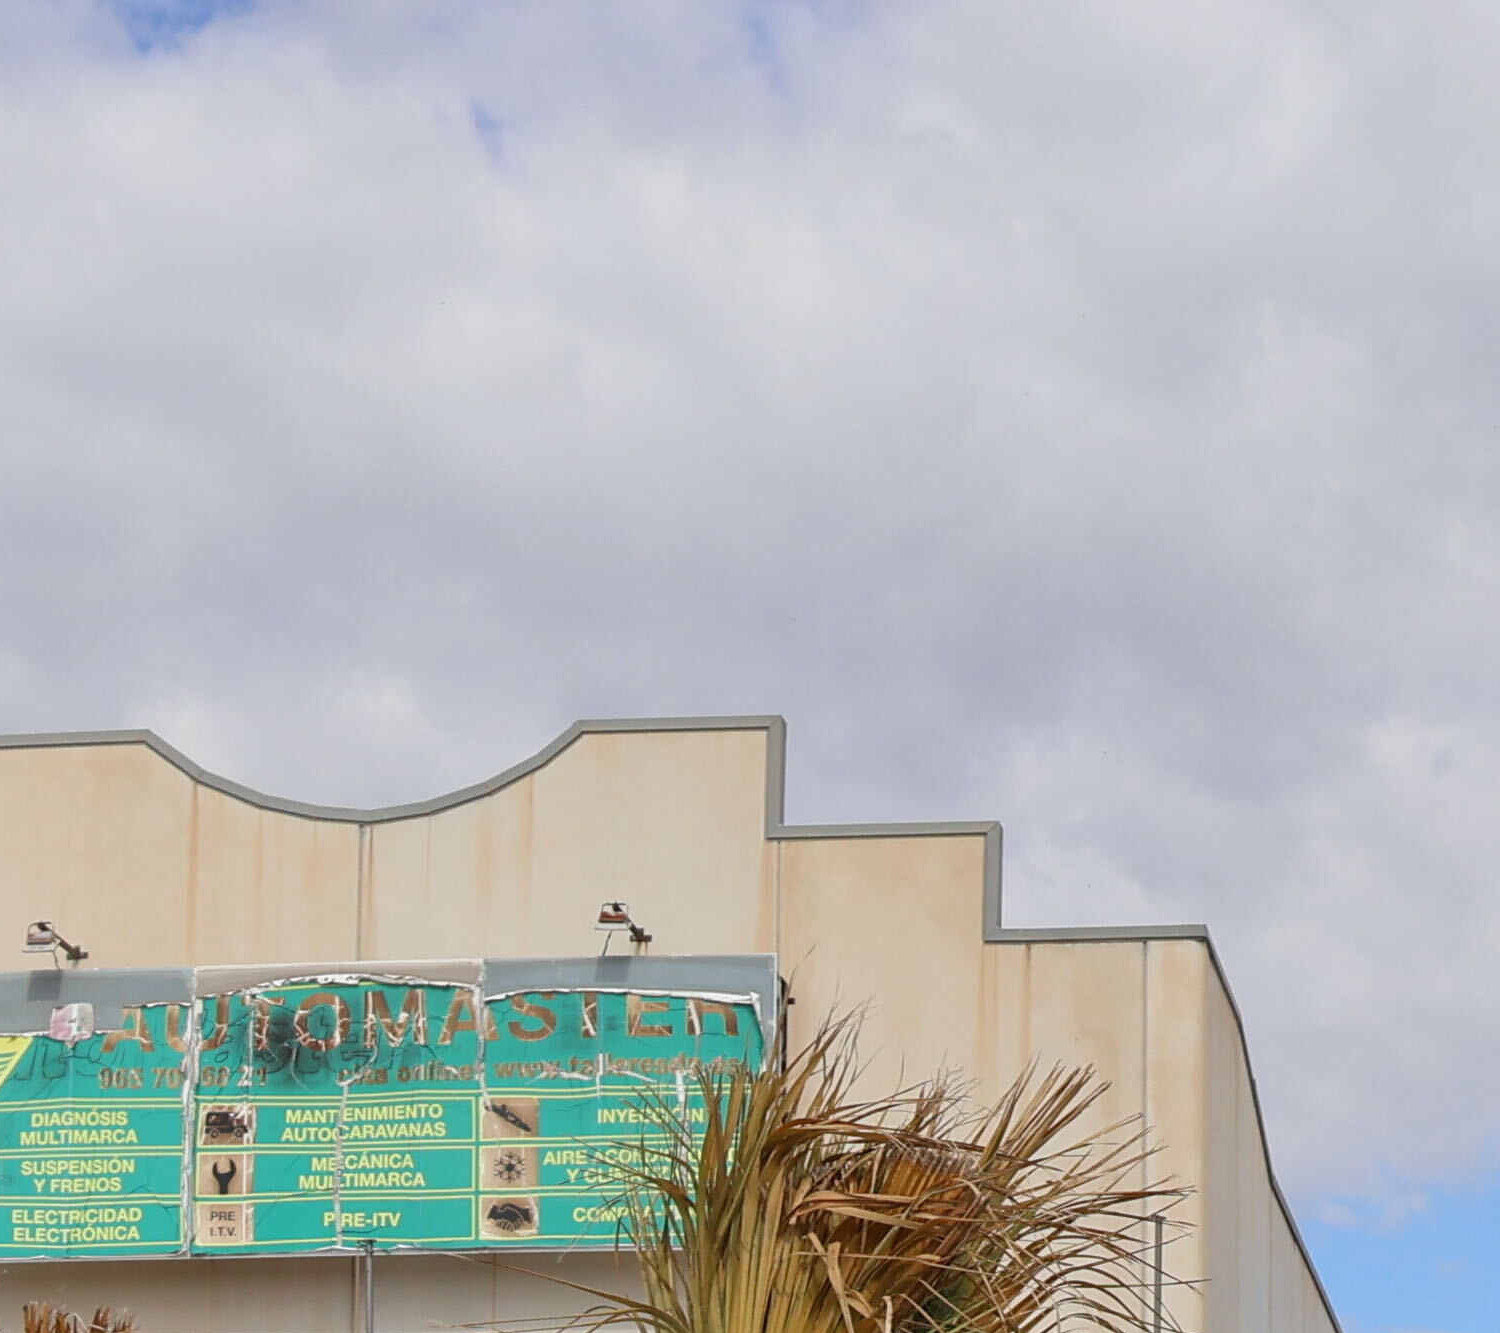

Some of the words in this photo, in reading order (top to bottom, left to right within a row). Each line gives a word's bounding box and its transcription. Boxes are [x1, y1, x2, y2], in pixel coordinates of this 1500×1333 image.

[31, 1107, 128, 1128] DIAGNÓSIS
[285, 1103, 443, 1124] MANTENIMIENTO
[19, 1129, 138, 1147] MULTIMARCA
[281, 1122, 446, 1142] AUTOCARAVANAS
[21, 1155, 135, 1175] SUSPENSIÓN
[311, 1151, 414, 1171] MECÁNICA
[543, 1149, 588, 1165] AIRE
[34, 1178, 45, 1193] Y
[51, 1177, 122, 1193] FRENOS
[299, 1171, 425, 1189] MULTIMARCA
[11, 1207, 142, 1224] ELECTRICIDAD
[210, 1210, 236, 1221] PRE
[323, 1211, 401, 1227] PRE-ITV
[13, 1223, 140, 1243] ELECTRÓNICA
[210, 1226, 237, 1237] I.T.V.
